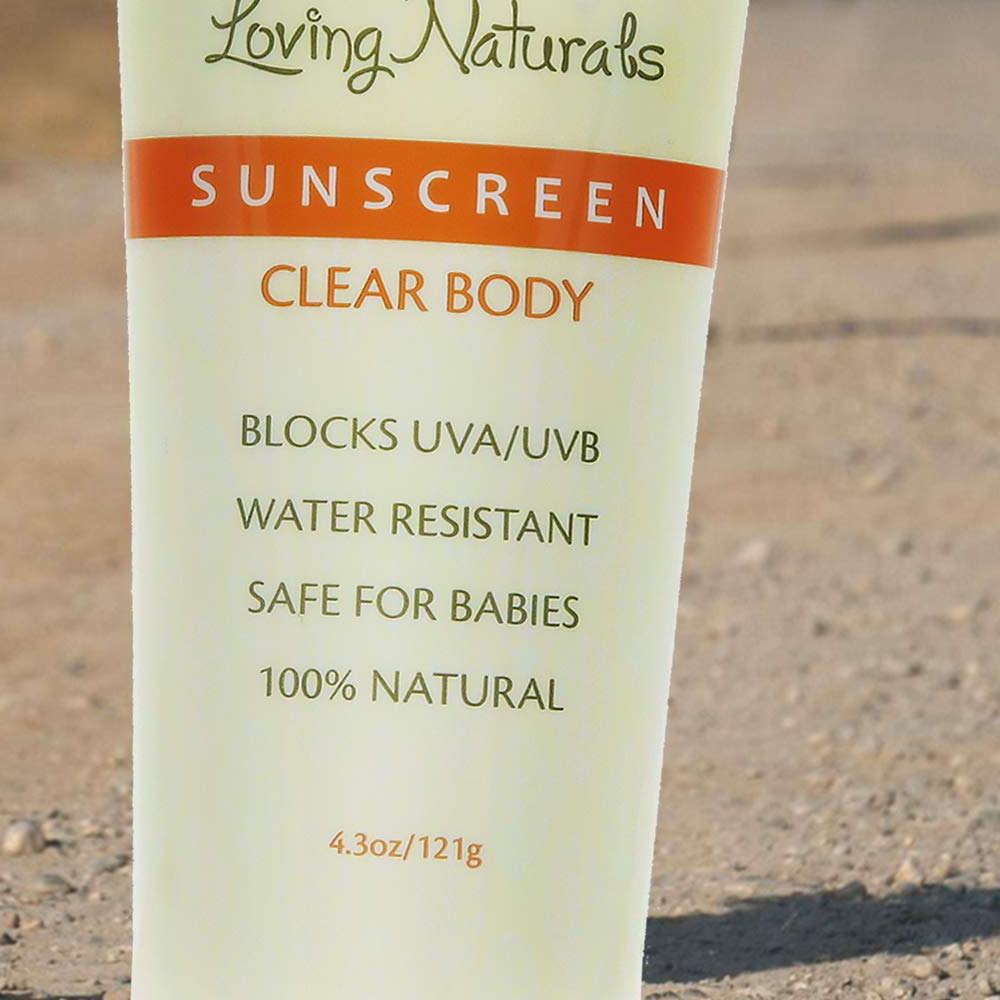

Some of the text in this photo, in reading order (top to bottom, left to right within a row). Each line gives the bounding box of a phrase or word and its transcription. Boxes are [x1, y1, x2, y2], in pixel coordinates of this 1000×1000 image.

[191, 164, 665, 230] SUNSCREEN
[260, 264, 595, 323] CLEAR BODY
[241, 414, 600, 464] BLOCKS UVA/UVB
[236, 497, 599, 547] WATER RESISTANT
[247, 580, 580, 629] SAFE FOR BABIES
[260, 666, 565, 712] 100% NATURAL
[328, 830, 484, 869] 4.3oz/121g
